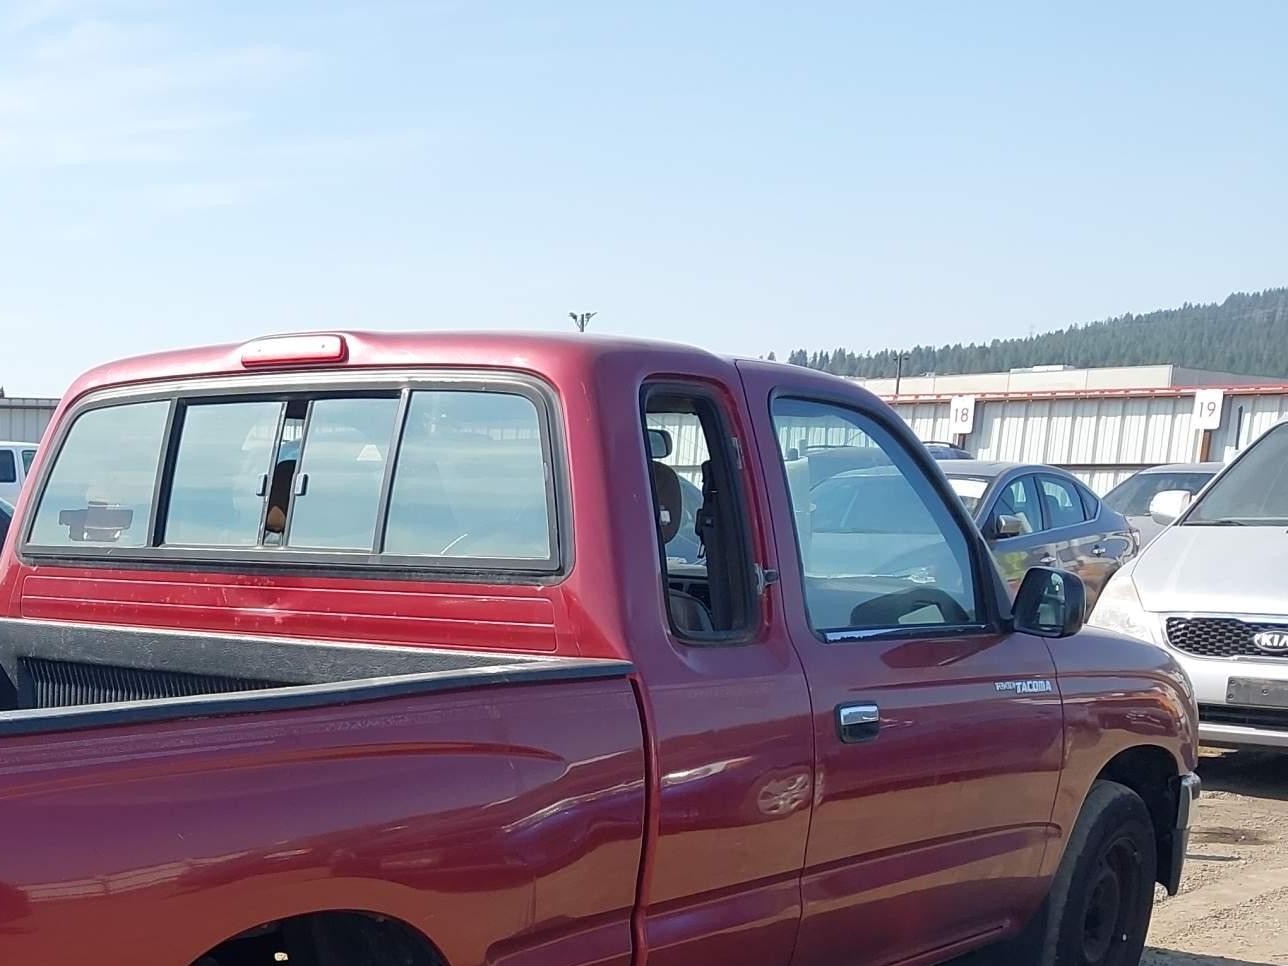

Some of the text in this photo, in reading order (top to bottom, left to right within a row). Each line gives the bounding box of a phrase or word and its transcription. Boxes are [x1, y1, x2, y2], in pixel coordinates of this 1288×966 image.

[955, 407, 969, 424] 18
[1199, 401, 1216, 418] 19
[1015, 680, 1052, 694] TACOMA
